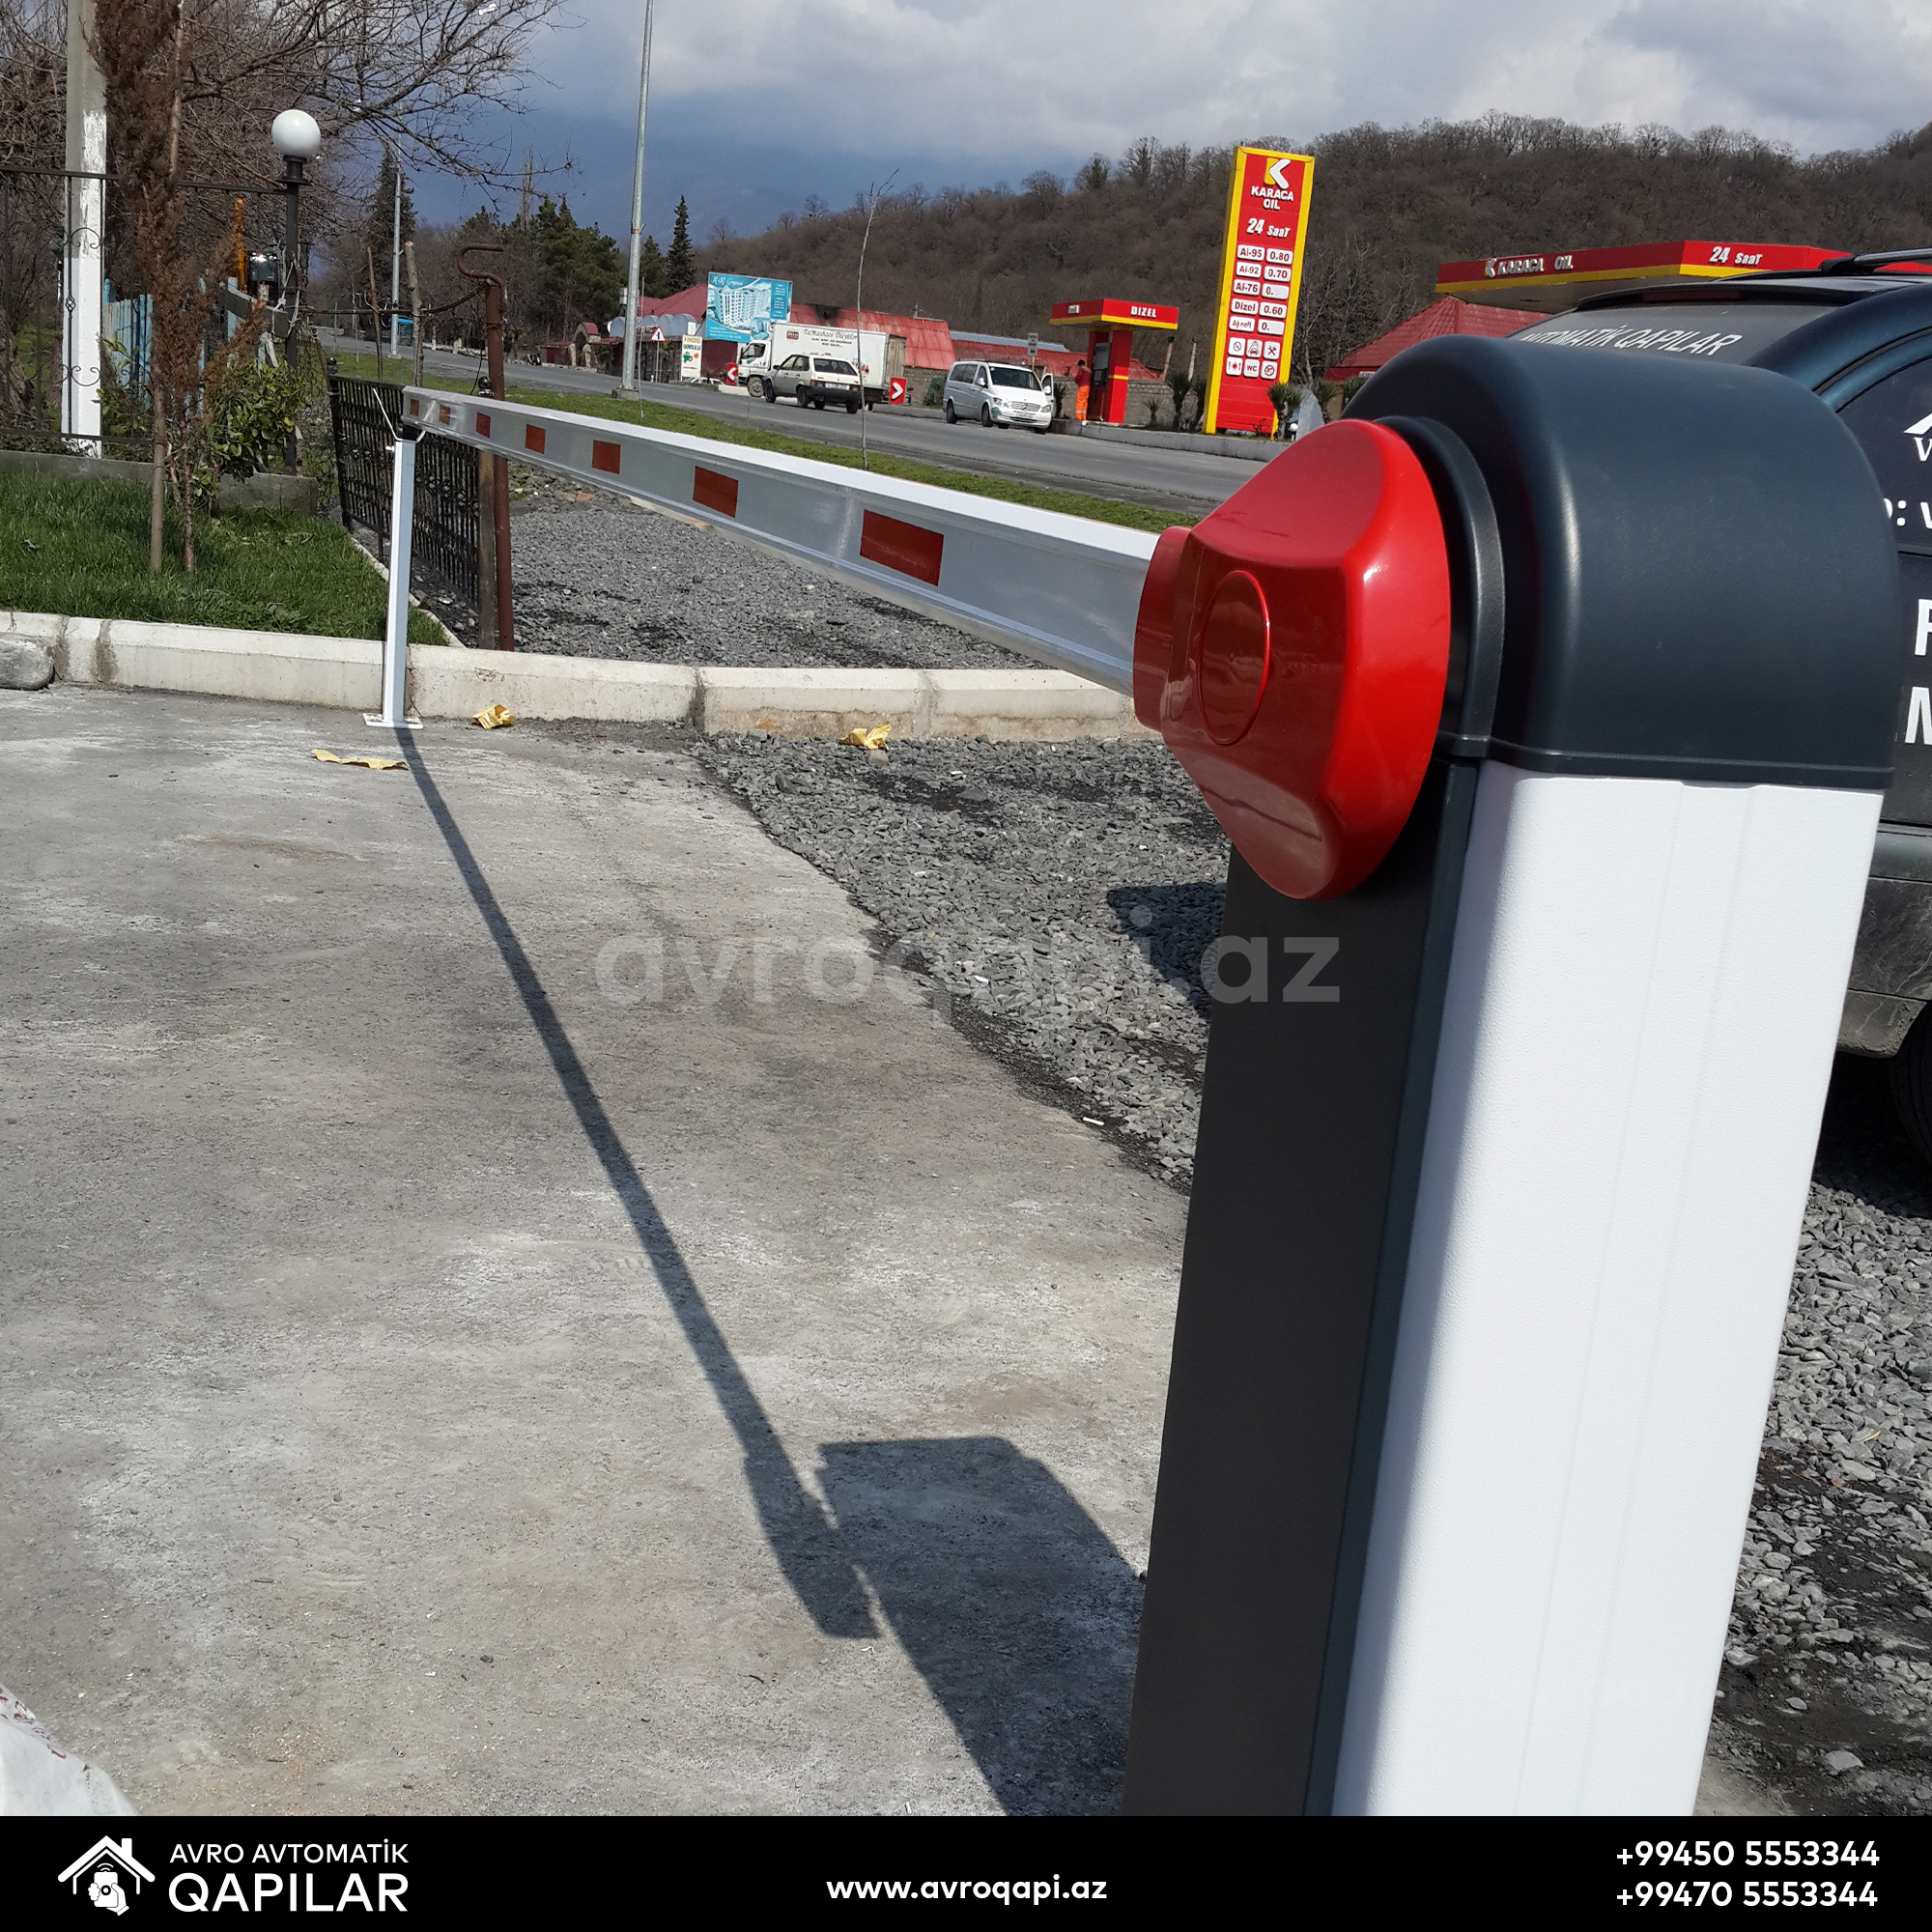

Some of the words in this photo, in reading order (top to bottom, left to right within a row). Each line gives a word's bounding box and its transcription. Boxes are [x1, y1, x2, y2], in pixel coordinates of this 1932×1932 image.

[1251, 185, 1293, 201] KARACA
[1264, 198, 1280, 210] OIL
[1246, 217, 1264, 234] 24
[1239, 247, 1263, 258] Ai-95
[1269, 251, 1290, 262] 0.80
[1709, 246, 1731, 264] 24
[1239, 265, 1259, 275] Ai-92
[1268, 269, 1288, 279] 0.70
[1498, 258, 1544, 275] KARACA
[1554, 255, 1574, 270] OIL
[1236, 282, 1259, 293] Ai-76
[1130, 305, 1157, 318] DIZEL
[1235, 301, 1256, 312] Dizel
[1264, 304, 1283, 316] 0.60
[1613, 327, 1744, 356] QAPILAR
